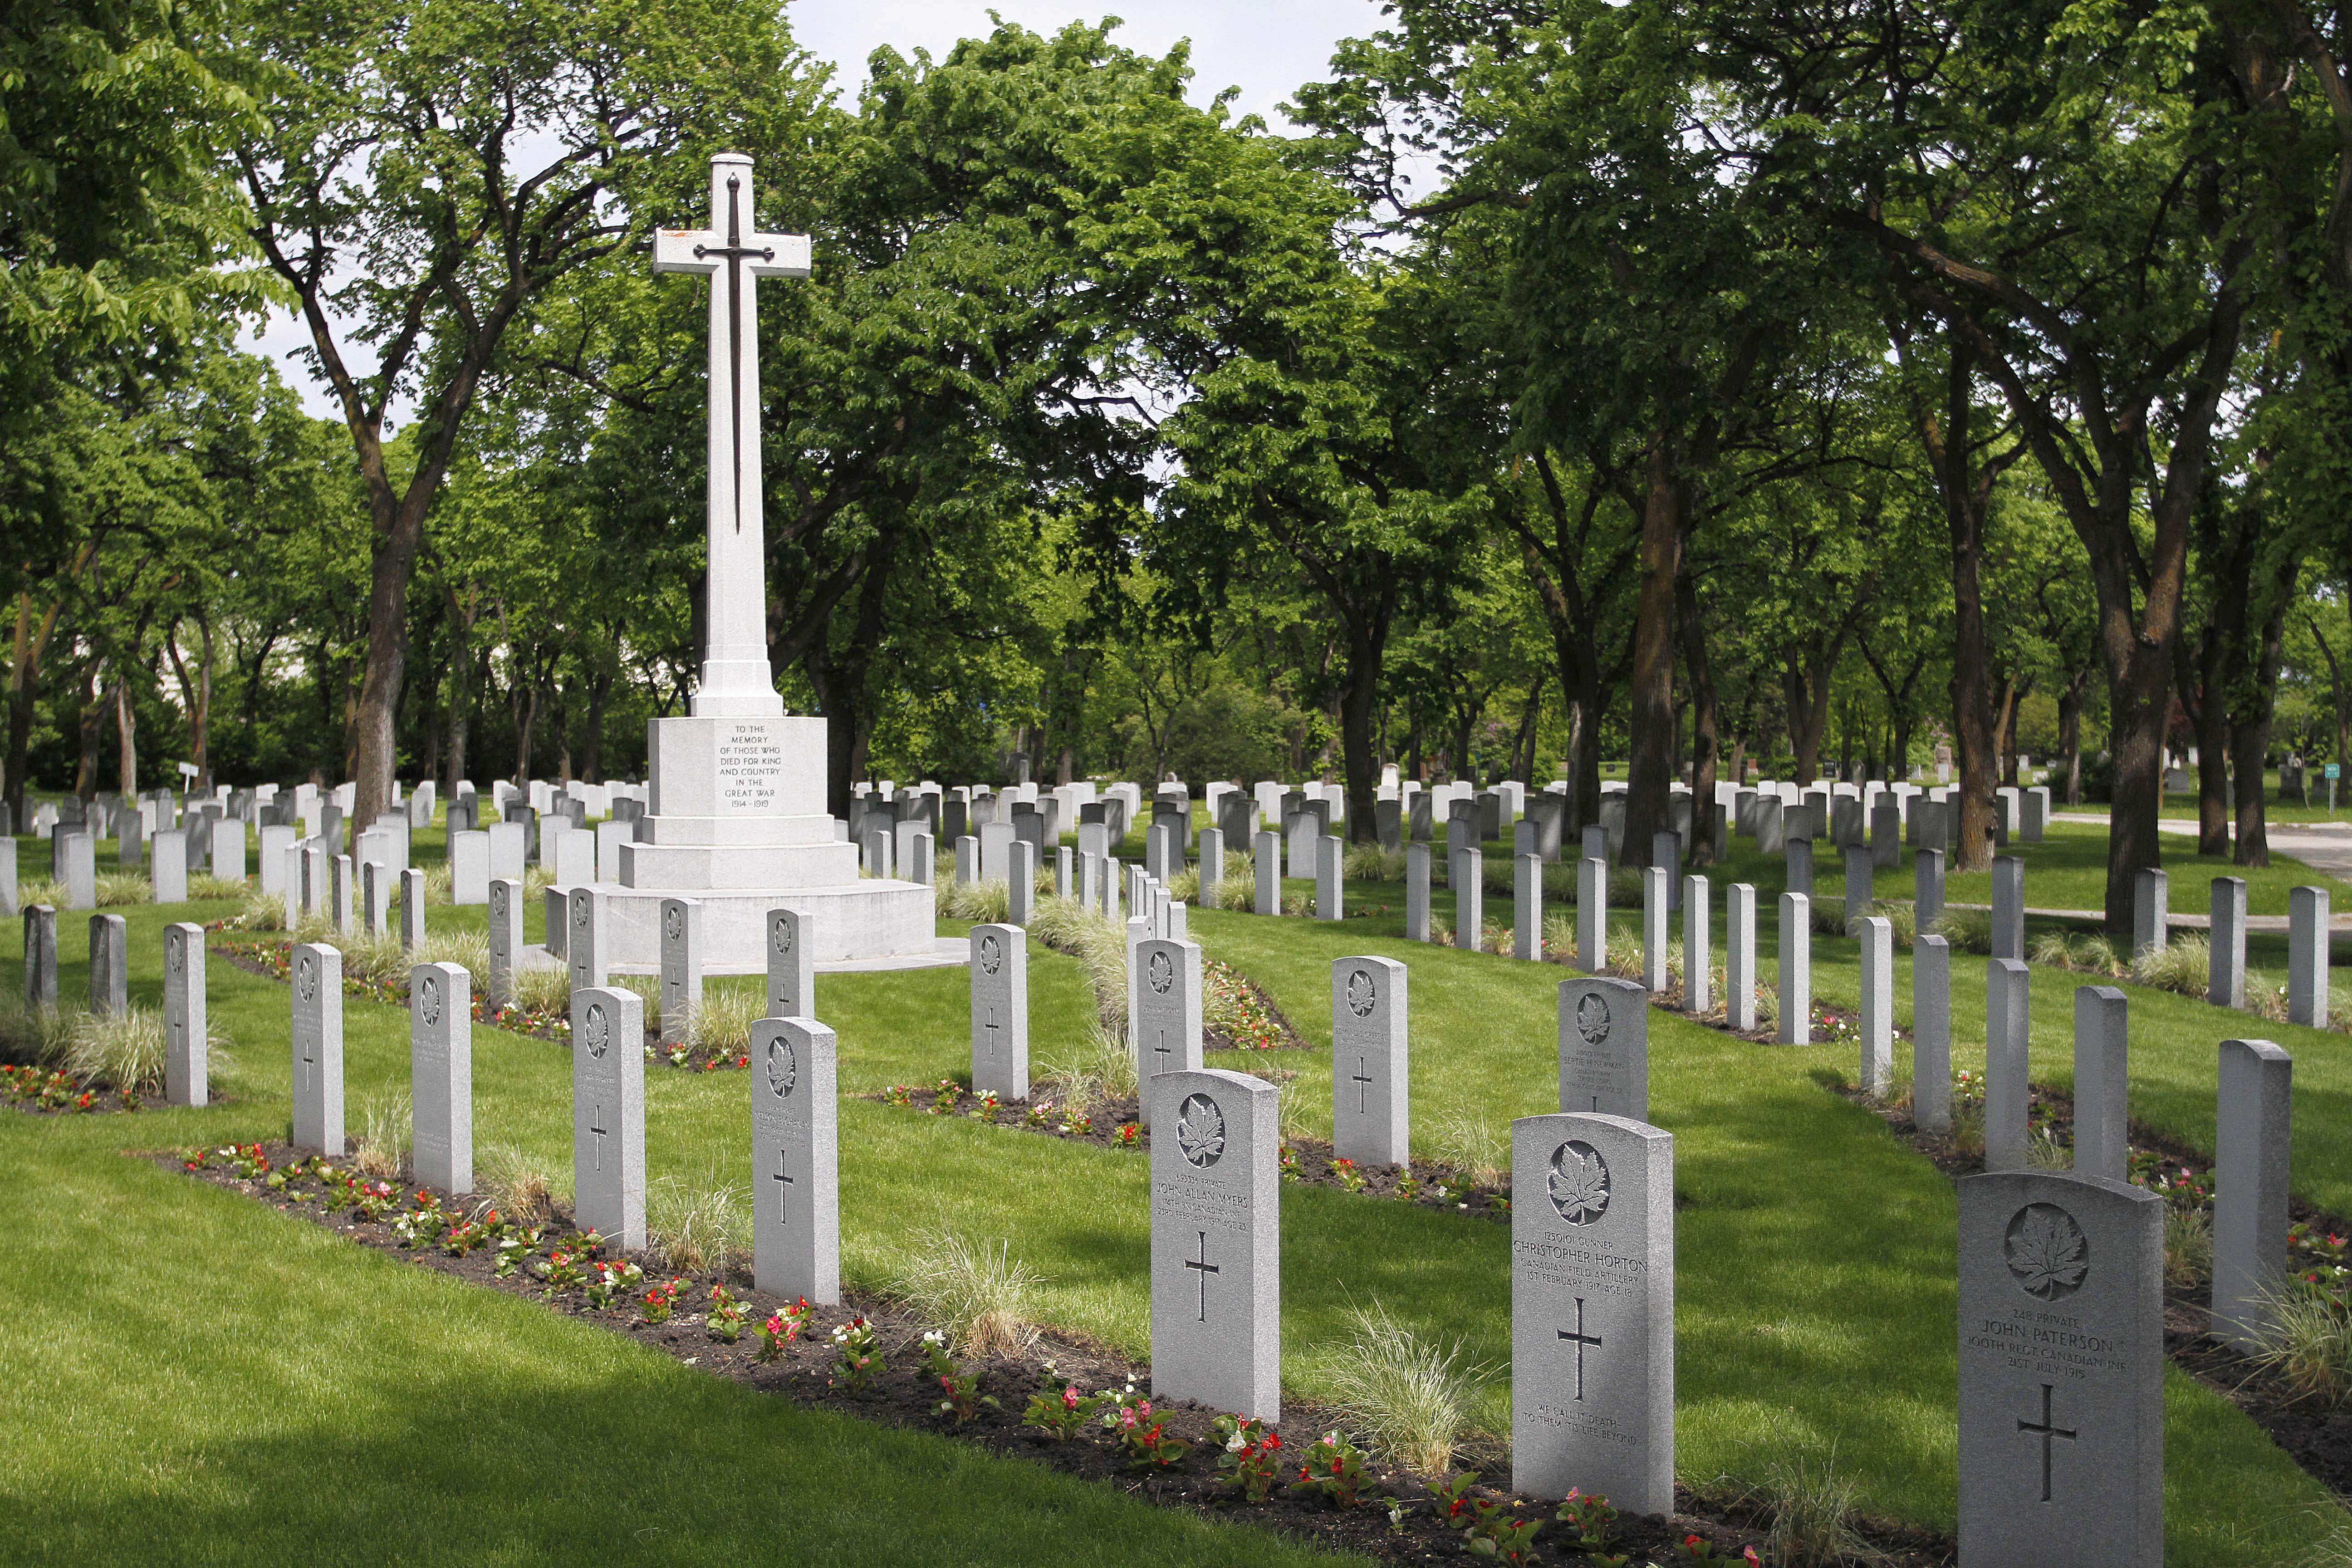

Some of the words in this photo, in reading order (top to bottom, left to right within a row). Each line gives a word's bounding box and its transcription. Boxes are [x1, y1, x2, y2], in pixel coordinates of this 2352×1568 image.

[1201, 1177, 1226, 1189] PRIVATE
[1157, 1183, 1181, 1196] JOHN
[1186, 1188, 1215, 1202] ALLAN
[1219, 1193, 1248, 1208] MYERS
[1175, 1211, 1206, 1224] FEBRUARY
[1224, 1220, 1236, 1229] AGE
[1191, 1203, 1227, 1217] CANADIAN
[1544, 1232, 1575, 1244] 1250101
[1578, 1237, 1612, 1251] GUNNER
[1513, 1240, 1590, 1264] CHRISTOPHER
[1595, 1254, 1647, 1273] HORTON
[1520, 1258, 1565, 1273] CANADIAN
[1568, 1266, 1590, 1277] FIELD
[1595, 1271, 1638, 1285] ARTILLERY
[1526, 1271, 1539, 1280] 1ST
[1542, 1274, 1583, 1288] FEBRUARY
[1585, 1281, 1600, 1291] 1917
[1604, 1286, 1620, 1295] AGE
[2013, 1308, 2032, 1321] 248
[2036, 1313, 2079, 1329] PRIVATE
[1981, 1320, 2025, 1338] JOHN
[2033, 1328, 2112, 1354] PATERSON
[1968, 1336, 2004, 1351] 100TH
[2041, 1349, 2102, 1367] CANADIAN
[2008, 1357, 2029, 1369] 21ST
[2035, 1362, 2060, 1374] JULY
[2065, 1367, 2085, 1379] 1915
[1538, 1404, 1549, 1414] WE
[1553, 1407, 1573, 1419] CALL
[1577, 1411, 1585, 1421] IT
[1523, 1412, 1535, 1423] TO
[1539, 1416, 1561, 1429] THEM
[1582, 1426, 1598, 1437] LIFE
[1602, 1430, 1637, 1446] BEYOND
